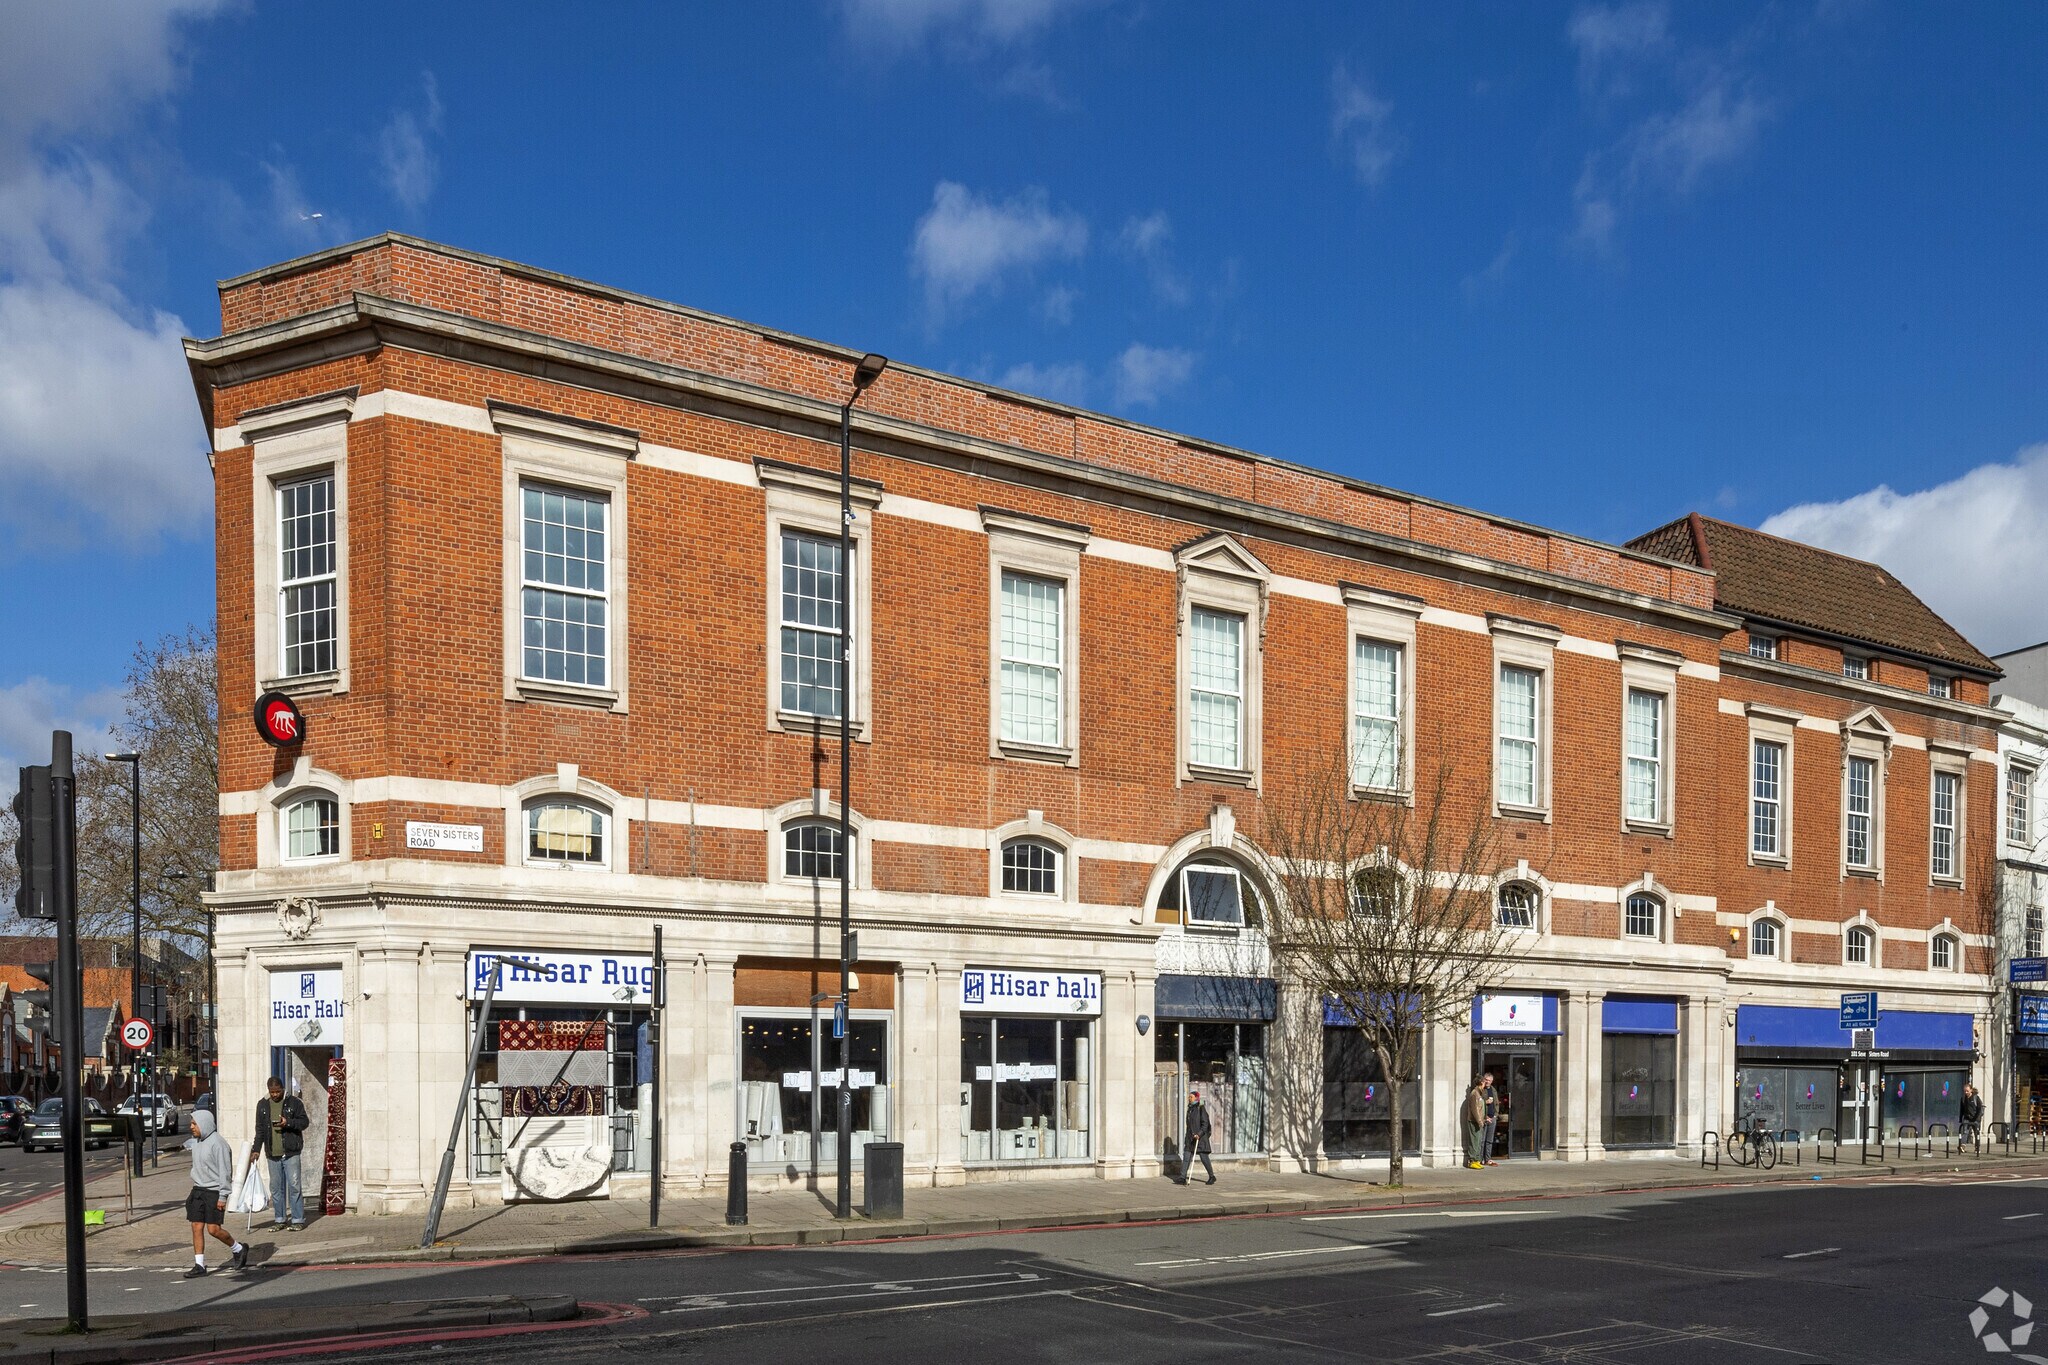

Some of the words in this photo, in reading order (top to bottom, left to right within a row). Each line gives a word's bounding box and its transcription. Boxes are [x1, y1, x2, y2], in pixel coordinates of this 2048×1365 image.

[410, 827, 440, 838] SEVEN
[443, 829, 480, 841] SISTERS
[410, 837, 436, 847] ROAD
[511, 955, 592, 984] Hisar
[990, 973, 1050, 997] Hisar
[273, 1001, 311, 1019] Hisar
[127, 1027, 148, 1040] 20
[1490, 1037, 1506, 1045] Seven
[1506, 1038, 1523, 1046] Sisters
[785, 1074, 799, 1086] BUY
[1743, 1102, 1759, 1111] Better
[1761, 1102, 1775, 1111] Lives
[1795, 1102, 1811, 1111] Better
[1812, 1101, 1825, 1110] Lives
